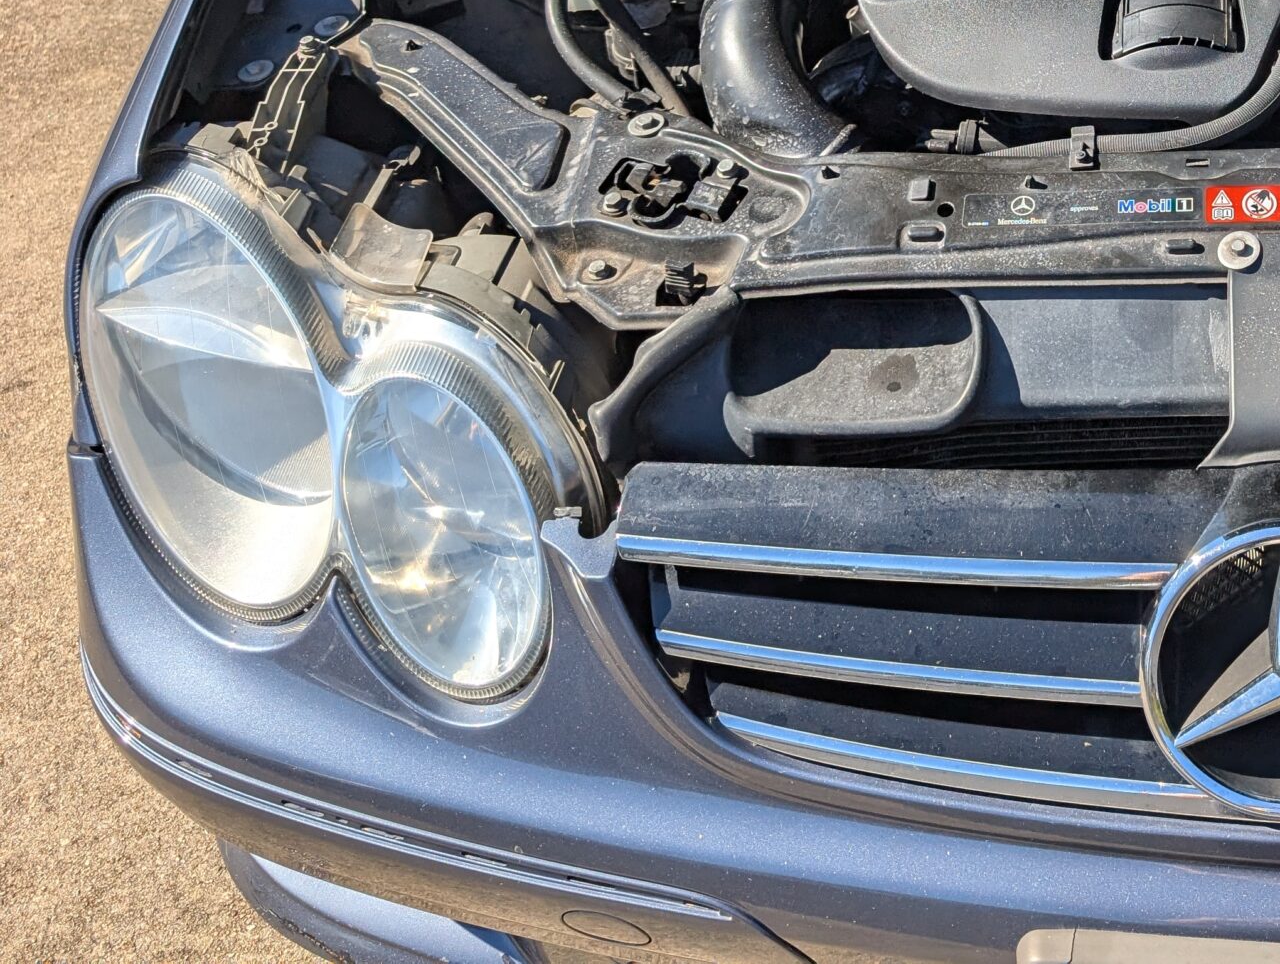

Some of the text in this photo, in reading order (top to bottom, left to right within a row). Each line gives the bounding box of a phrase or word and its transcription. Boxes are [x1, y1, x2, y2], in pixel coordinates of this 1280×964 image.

[1070, 205, 1098, 213] approves
[1117, 197, 1171, 213] Mobil
[997, 217, 1047, 226] Mercedes-Benz
